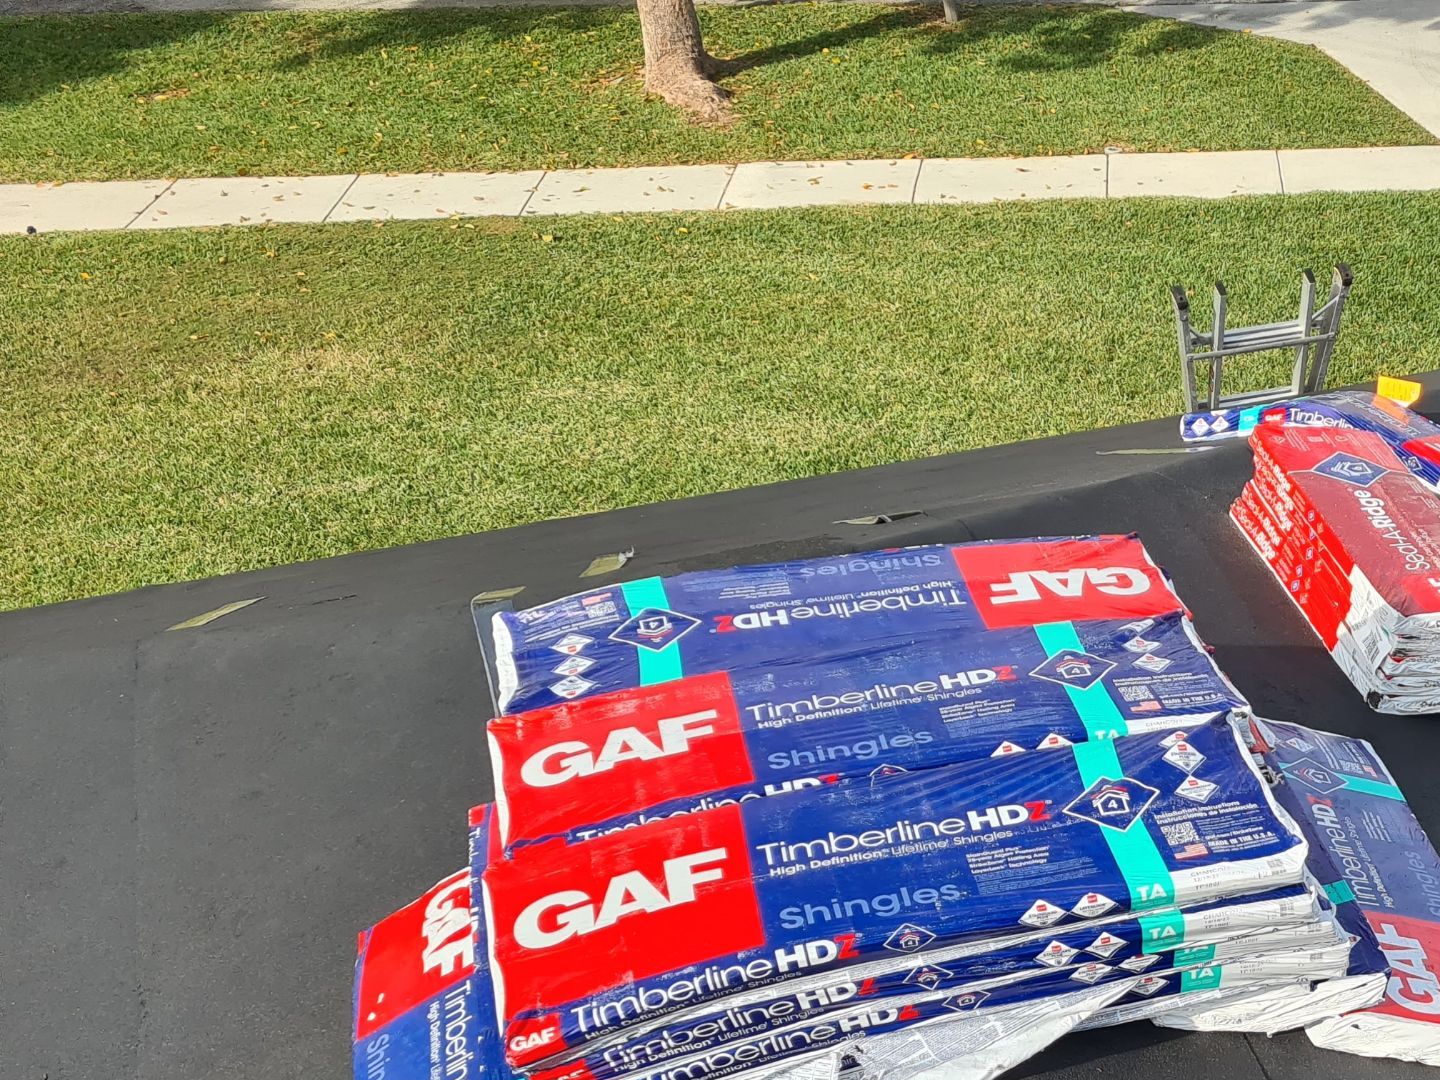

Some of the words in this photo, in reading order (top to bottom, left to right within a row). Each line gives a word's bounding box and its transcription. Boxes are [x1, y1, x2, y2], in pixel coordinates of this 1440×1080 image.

[1354, 490, 1431, 571] Seal-A-Ridge
[800, 554, 941, 577] Shingles
[923, 579, 953, 590] High
[989, 566, 1152, 605] GAF
[750, 599, 802, 611] Shingles
[791, 587, 968, 620] Timberline
[862, 584, 921, 598] Definition
[712, 608, 790, 633] HDZ
[746, 681, 939, 722] Timberline
[939, 664, 1017, 690] HDZ
[757, 715, 792, 729] High
[795, 705, 862, 723] Definition
[926, 686, 982, 702] Shingles
[520, 708, 718, 787] GAF
[768, 730, 934, 770] Shingles
[755, 819, 966, 866] Timberline
[966, 800, 1051, 832] HDZ
[770, 862, 805, 877] High
[809, 850, 882, 871] Definition
[890, 838, 949, 857] Lifetime
[952, 828, 1013, 847] Shingles
[514, 848, 727, 949] GAF
[778, 883, 961, 930] Shingles
[1136, 883, 1168, 901] TA
[422, 866, 476, 977] GAF
[1149, 925, 1177, 940] TA
[510, 1026, 556, 1053] GAF
[571, 958, 773, 1033] Timberline
[774, 932, 860, 973] HDZ
[1188, 967, 1215, 980] TA
[428, 1001, 439, 1020] High
[603, 1000, 795, 1068] Timberline
[795, 977, 880, 1010] HDZ
[839, 1003, 920, 1033] HDZ
[430, 1021, 440, 1062] Definition
[648, 1038, 712, 1061] Definition
[717, 1021, 768, 1043] Lifetime
[772, 1007, 825, 1026] Shingles
